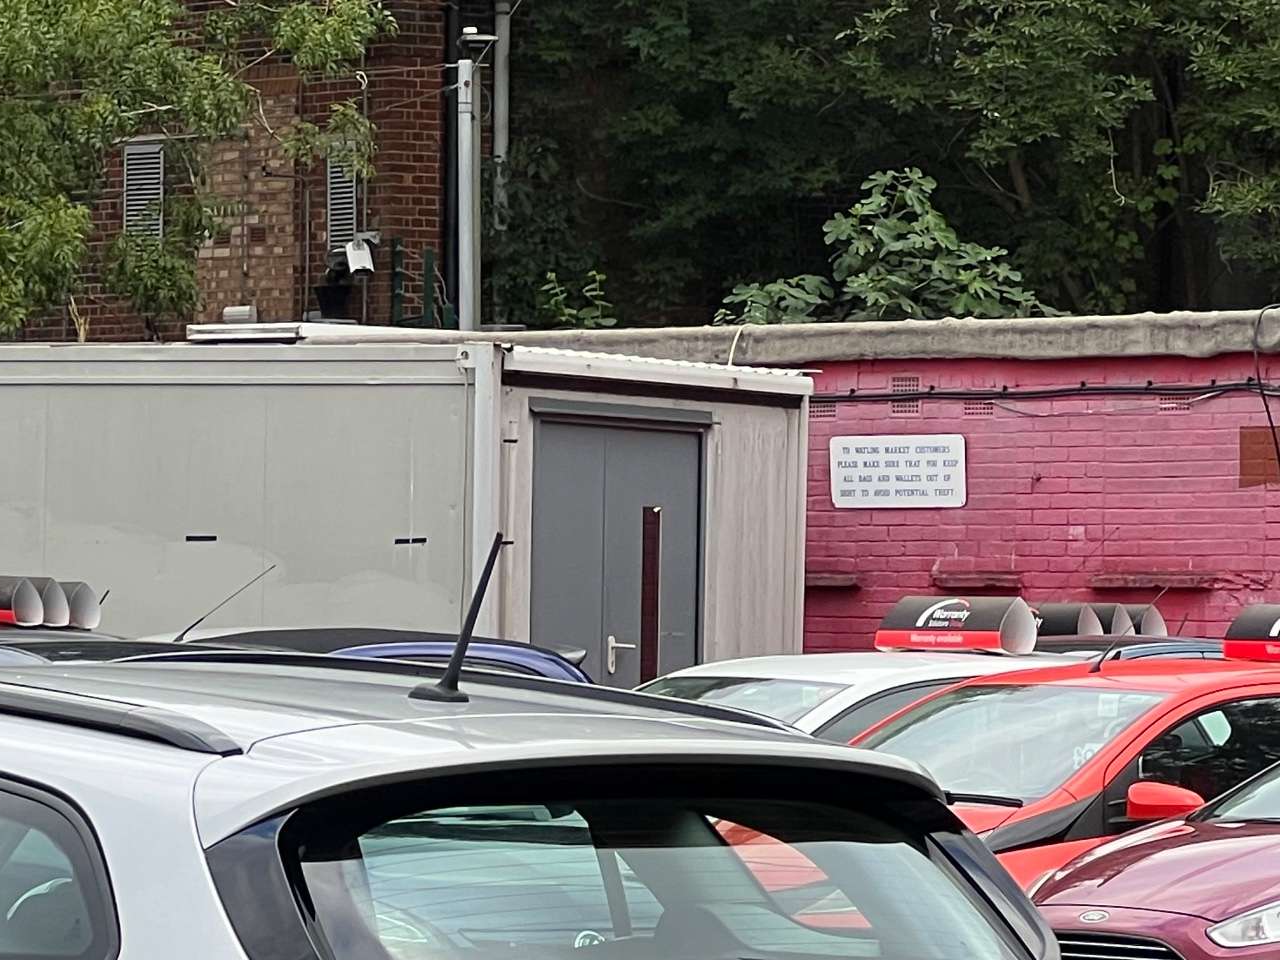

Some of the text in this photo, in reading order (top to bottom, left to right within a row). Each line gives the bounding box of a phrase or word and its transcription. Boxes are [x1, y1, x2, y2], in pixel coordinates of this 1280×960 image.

[884, 446, 910, 454] MARKET
[915, 446, 950, 454] CUSTOMERS
[837, 460, 858, 468] PLEASE
[904, 460, 920, 468] THAT
[942, 459, 959, 468] KEEP
[894, 474, 922, 482] WALLETS
[926, 474, 938, 482] OUT
[894, 488, 928, 497] POTENTIAL
[934, 488, 954, 497] THEFT
[932, 608, 970, 622] Warranty
